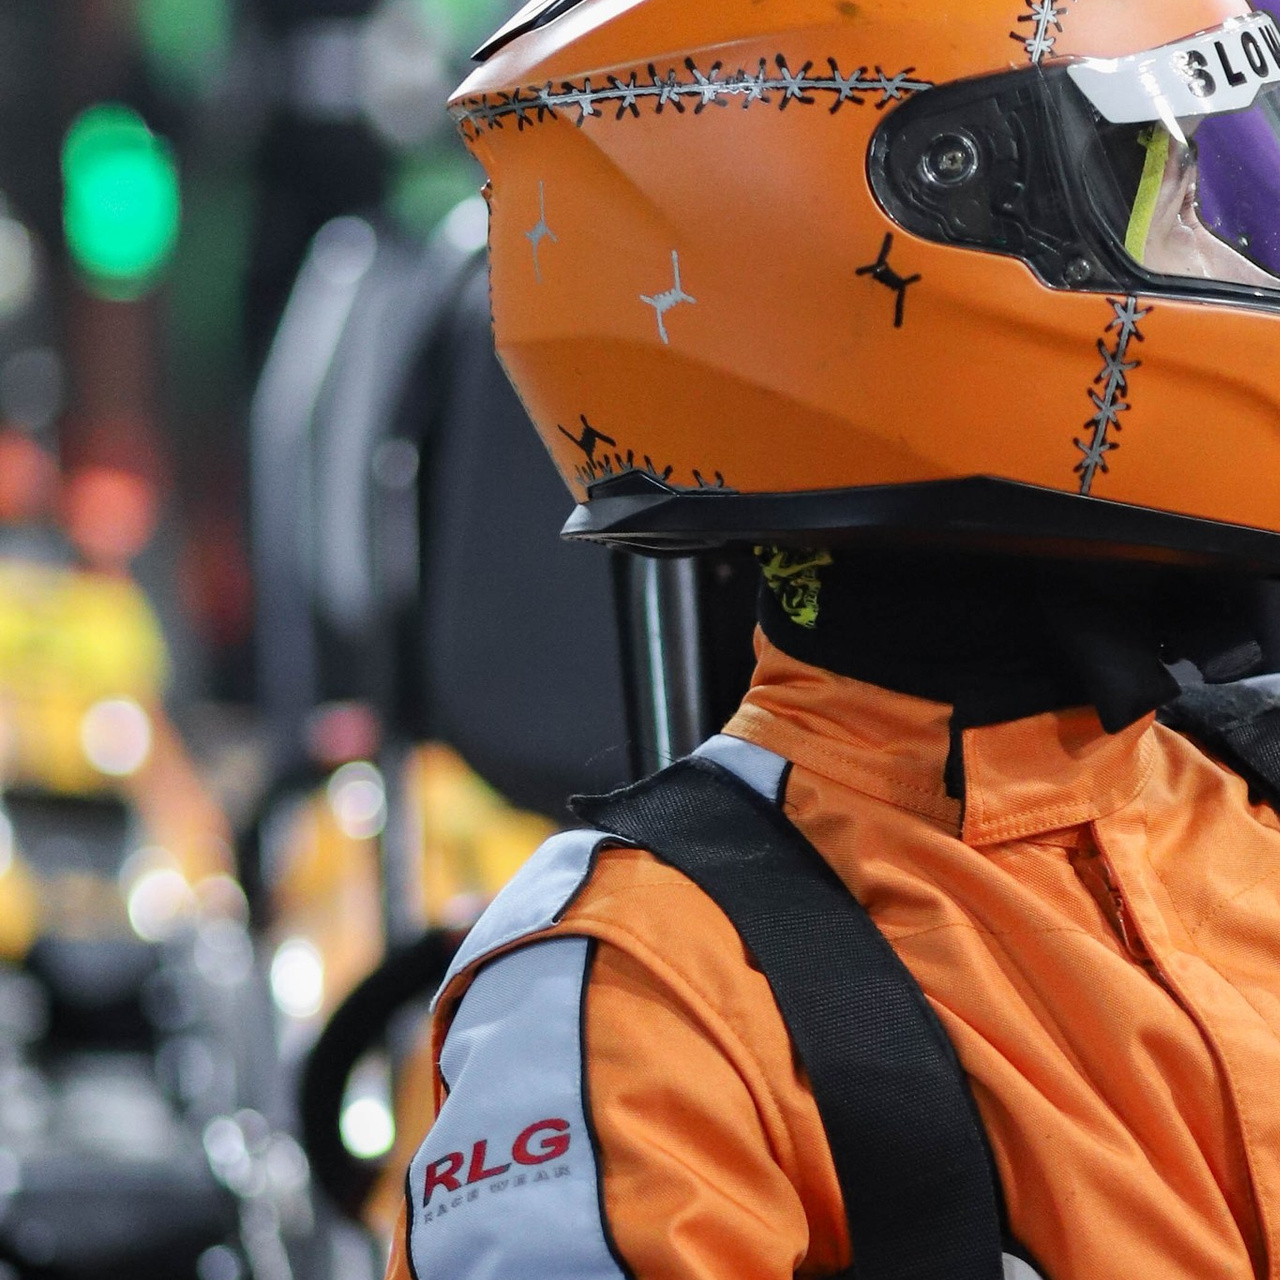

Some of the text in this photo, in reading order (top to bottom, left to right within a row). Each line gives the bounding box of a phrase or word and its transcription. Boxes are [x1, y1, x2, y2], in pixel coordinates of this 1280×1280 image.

[422, 1118, 571, 1208] RLG
[422, 1164, 571, 1224] RACE WEAR
